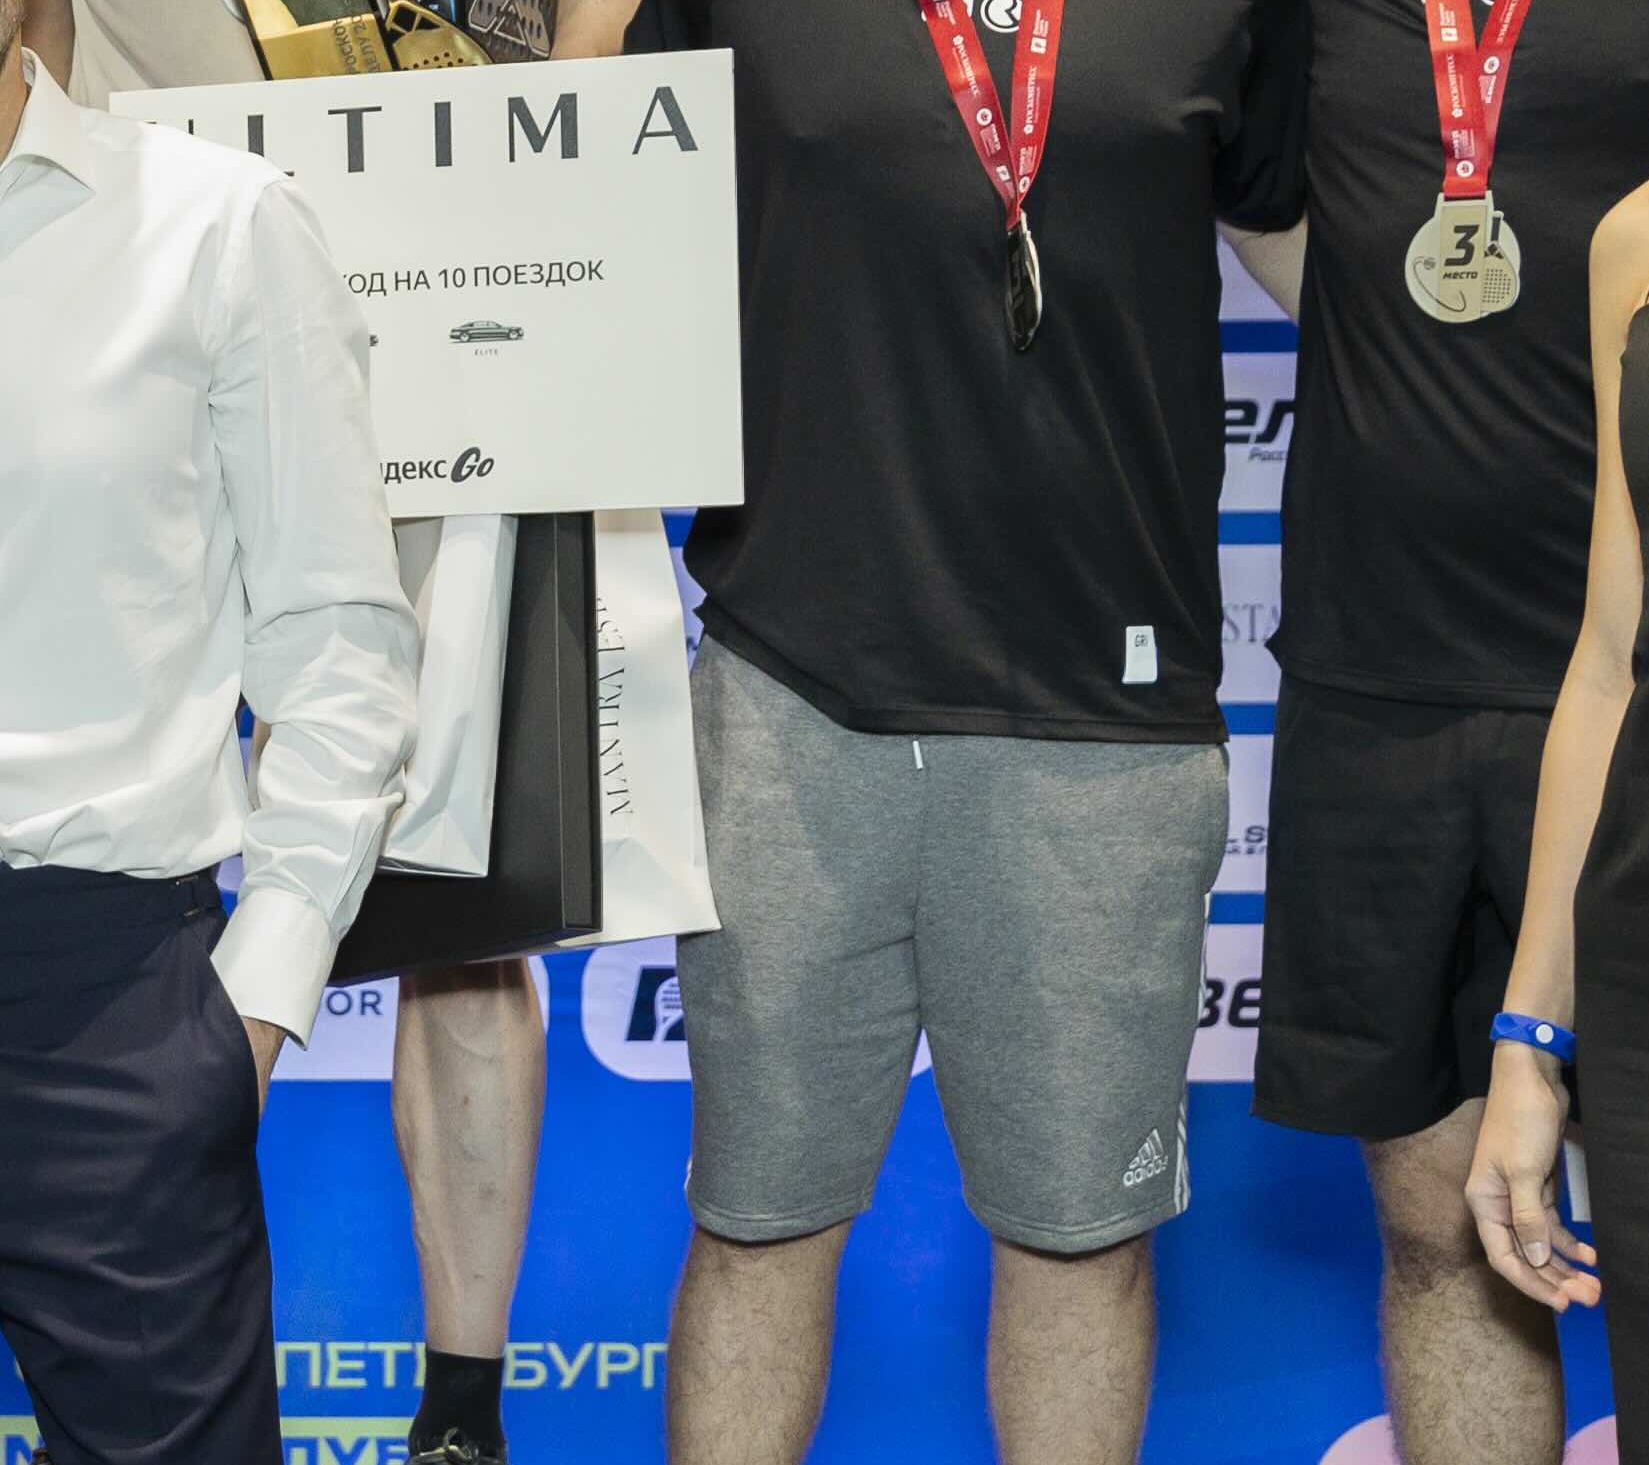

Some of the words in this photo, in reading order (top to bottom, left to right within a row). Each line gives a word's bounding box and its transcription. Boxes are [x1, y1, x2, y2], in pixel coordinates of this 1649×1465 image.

[144, 85, 700, 177] LTIMA
[1443, 224, 1481, 267] 3
[392, 268, 432, 292] НА
[437, 266, 468, 290] 10
[473, 257, 606, 290] ПОЕЗДОК
[380, 454, 449, 487] декс
[449, 445, 496, 485] Go
